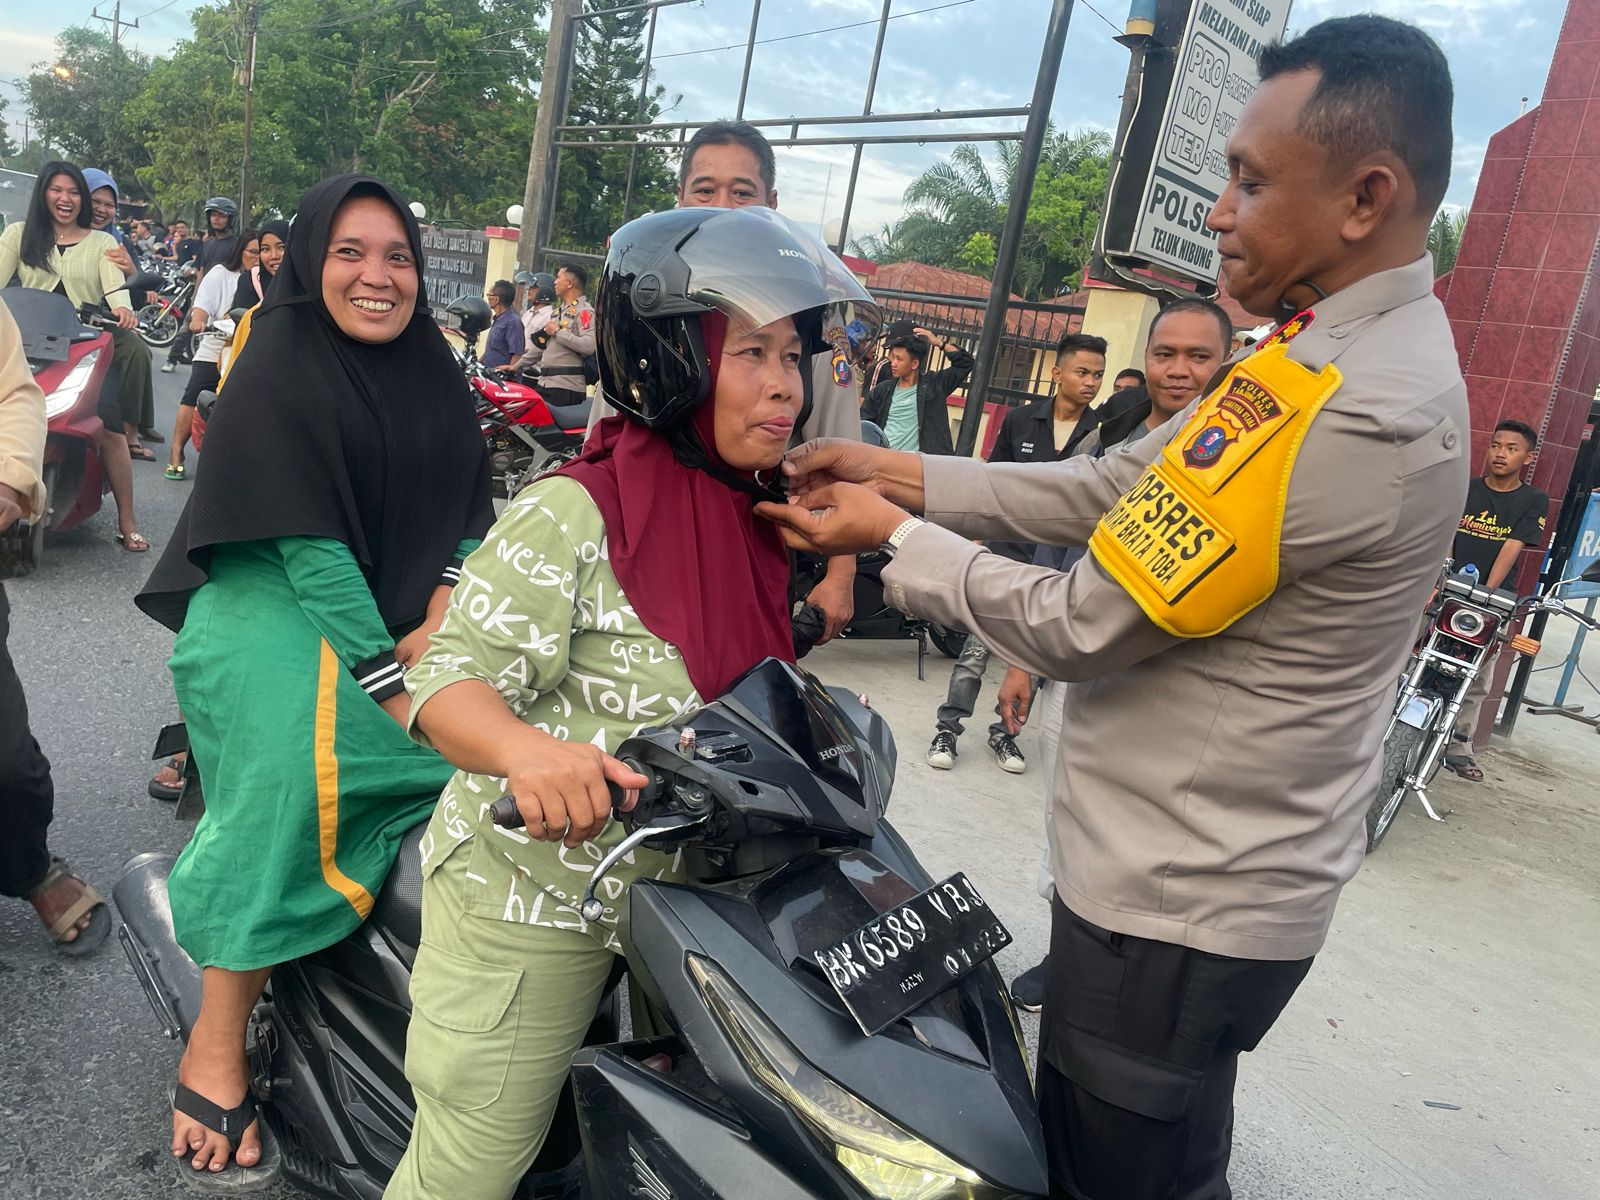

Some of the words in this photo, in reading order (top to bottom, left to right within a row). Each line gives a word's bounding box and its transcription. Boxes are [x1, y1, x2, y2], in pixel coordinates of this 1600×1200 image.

[1199, 2, 1250, 52] MELAYANI
[1246, 39, 1264, 60] AN
[1247, 0, 1271, 28] SIAP
[1188, 44, 1225, 88] PRO
[1182, 86, 1212, 125] MO
[1170, 124, 1204, 166] TER
[1149, 183, 1220, 241] POLSE
[1151, 227, 1181, 257] TELUK
[1178, 238, 1213, 270] NIBUNG
[1239, 380, 1274, 410] POLRES
[1254, 400, 1269, 419] BALAI
[1126, 474, 1215, 561] OPSRES
[1117, 519, 1156, 560] BRATA
[1145, 547, 1182, 586] TOBA
[817, 744, 856, 760] HONDA
[859, 907, 926, 967] 6589
